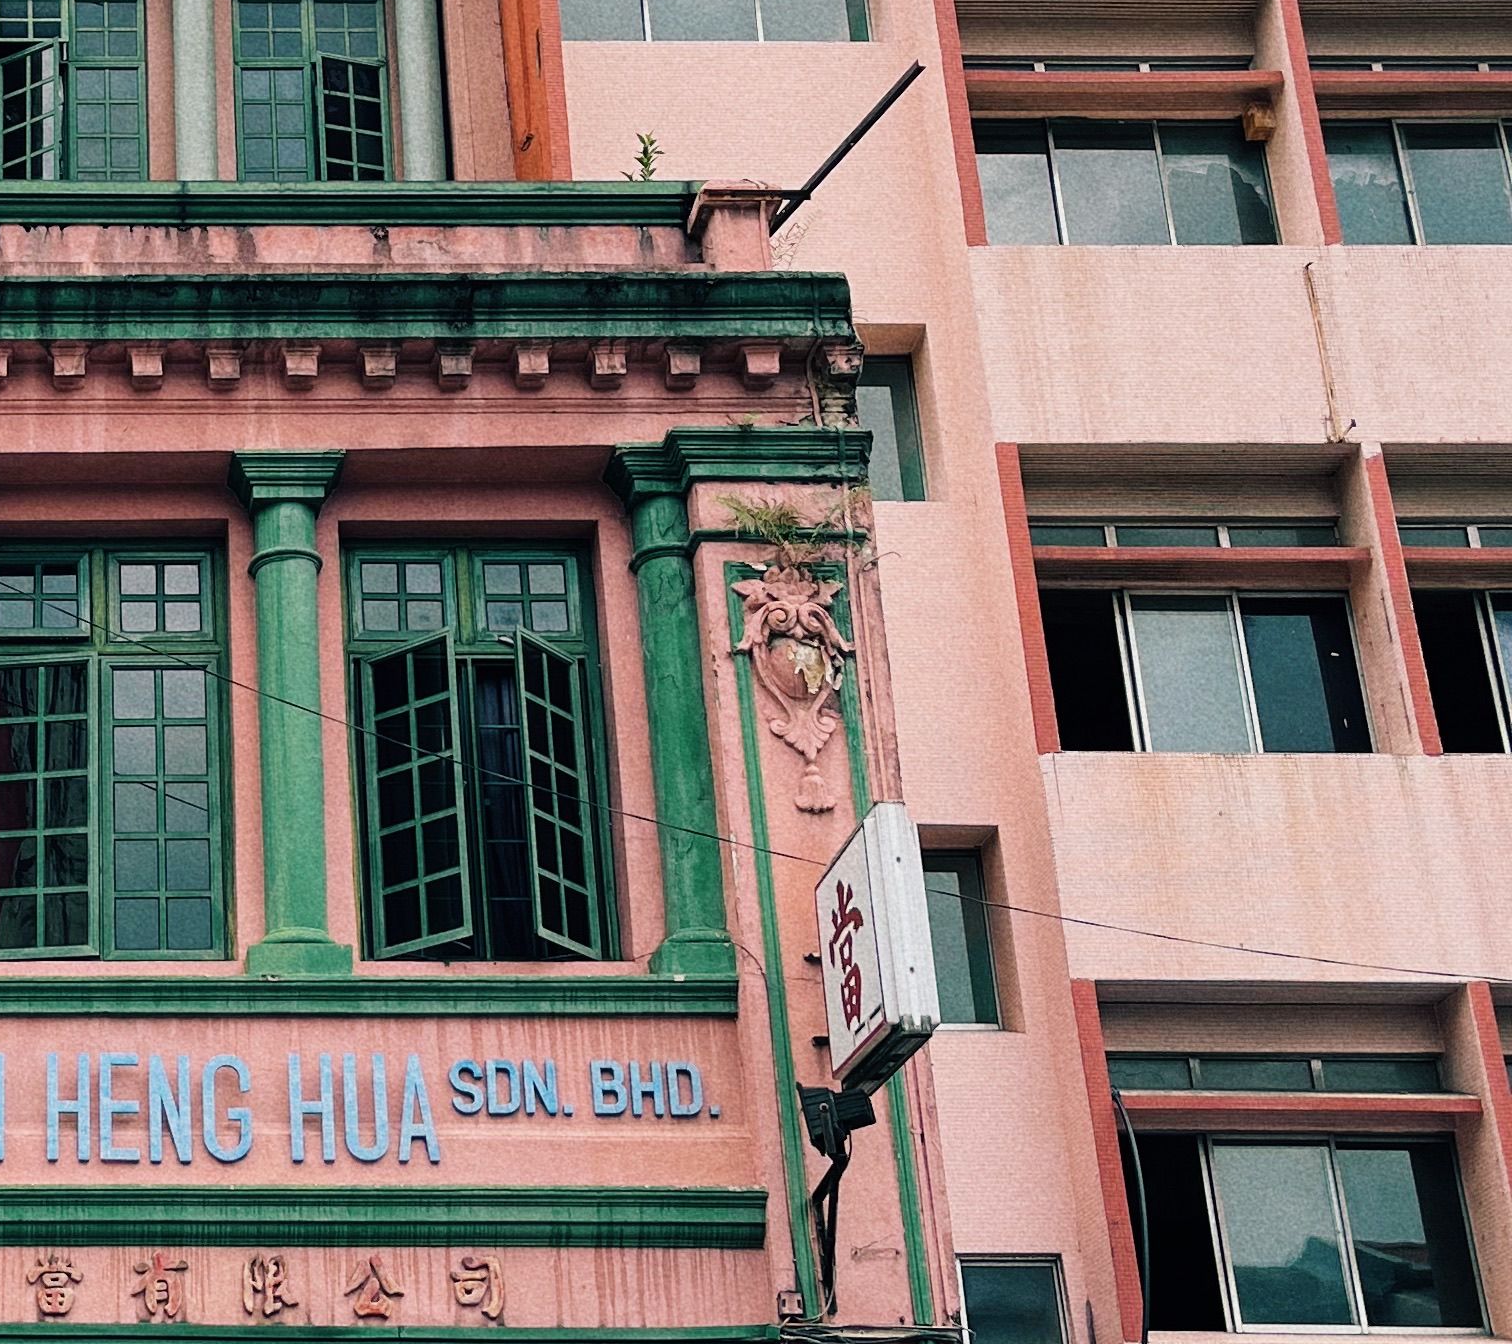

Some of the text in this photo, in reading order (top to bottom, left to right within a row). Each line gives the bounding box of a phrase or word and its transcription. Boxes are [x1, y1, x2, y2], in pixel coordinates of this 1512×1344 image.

[46, 1052, 253, 1164] HENG
[287, 1052, 441, 1164] HUA
[448, 1059, 574, 1117] SDN.
[590, 1059, 721, 1119] BHD.
